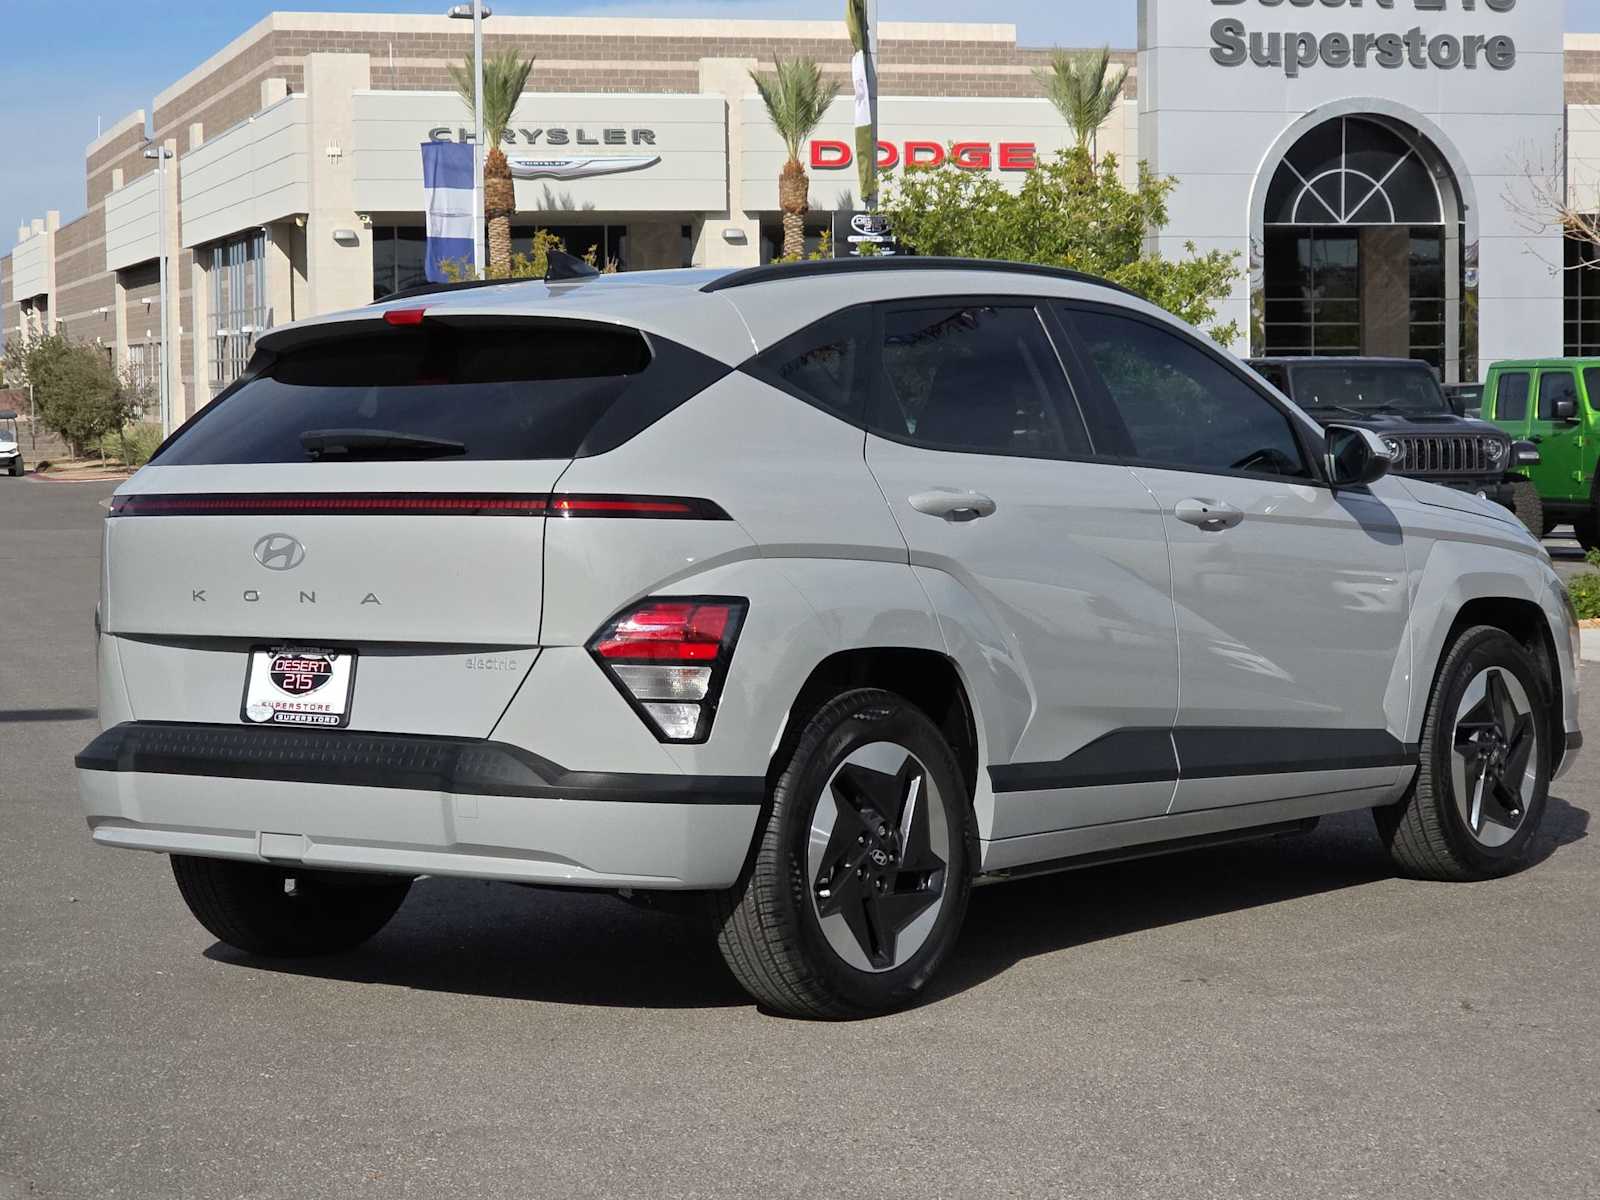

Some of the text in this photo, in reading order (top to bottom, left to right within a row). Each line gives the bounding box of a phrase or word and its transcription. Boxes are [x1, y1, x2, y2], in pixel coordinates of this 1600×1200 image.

[1210, 18, 1516, 78] Superstore
[192, 590, 382, 605] KONA
[275, 660, 328, 673] DESERT
[465, 656, 517, 670] electric
[282, 674, 313, 689] 215
[261, 701, 331, 711] SUPERSTORE
[277, 714, 336, 723] SUPERSTORE
